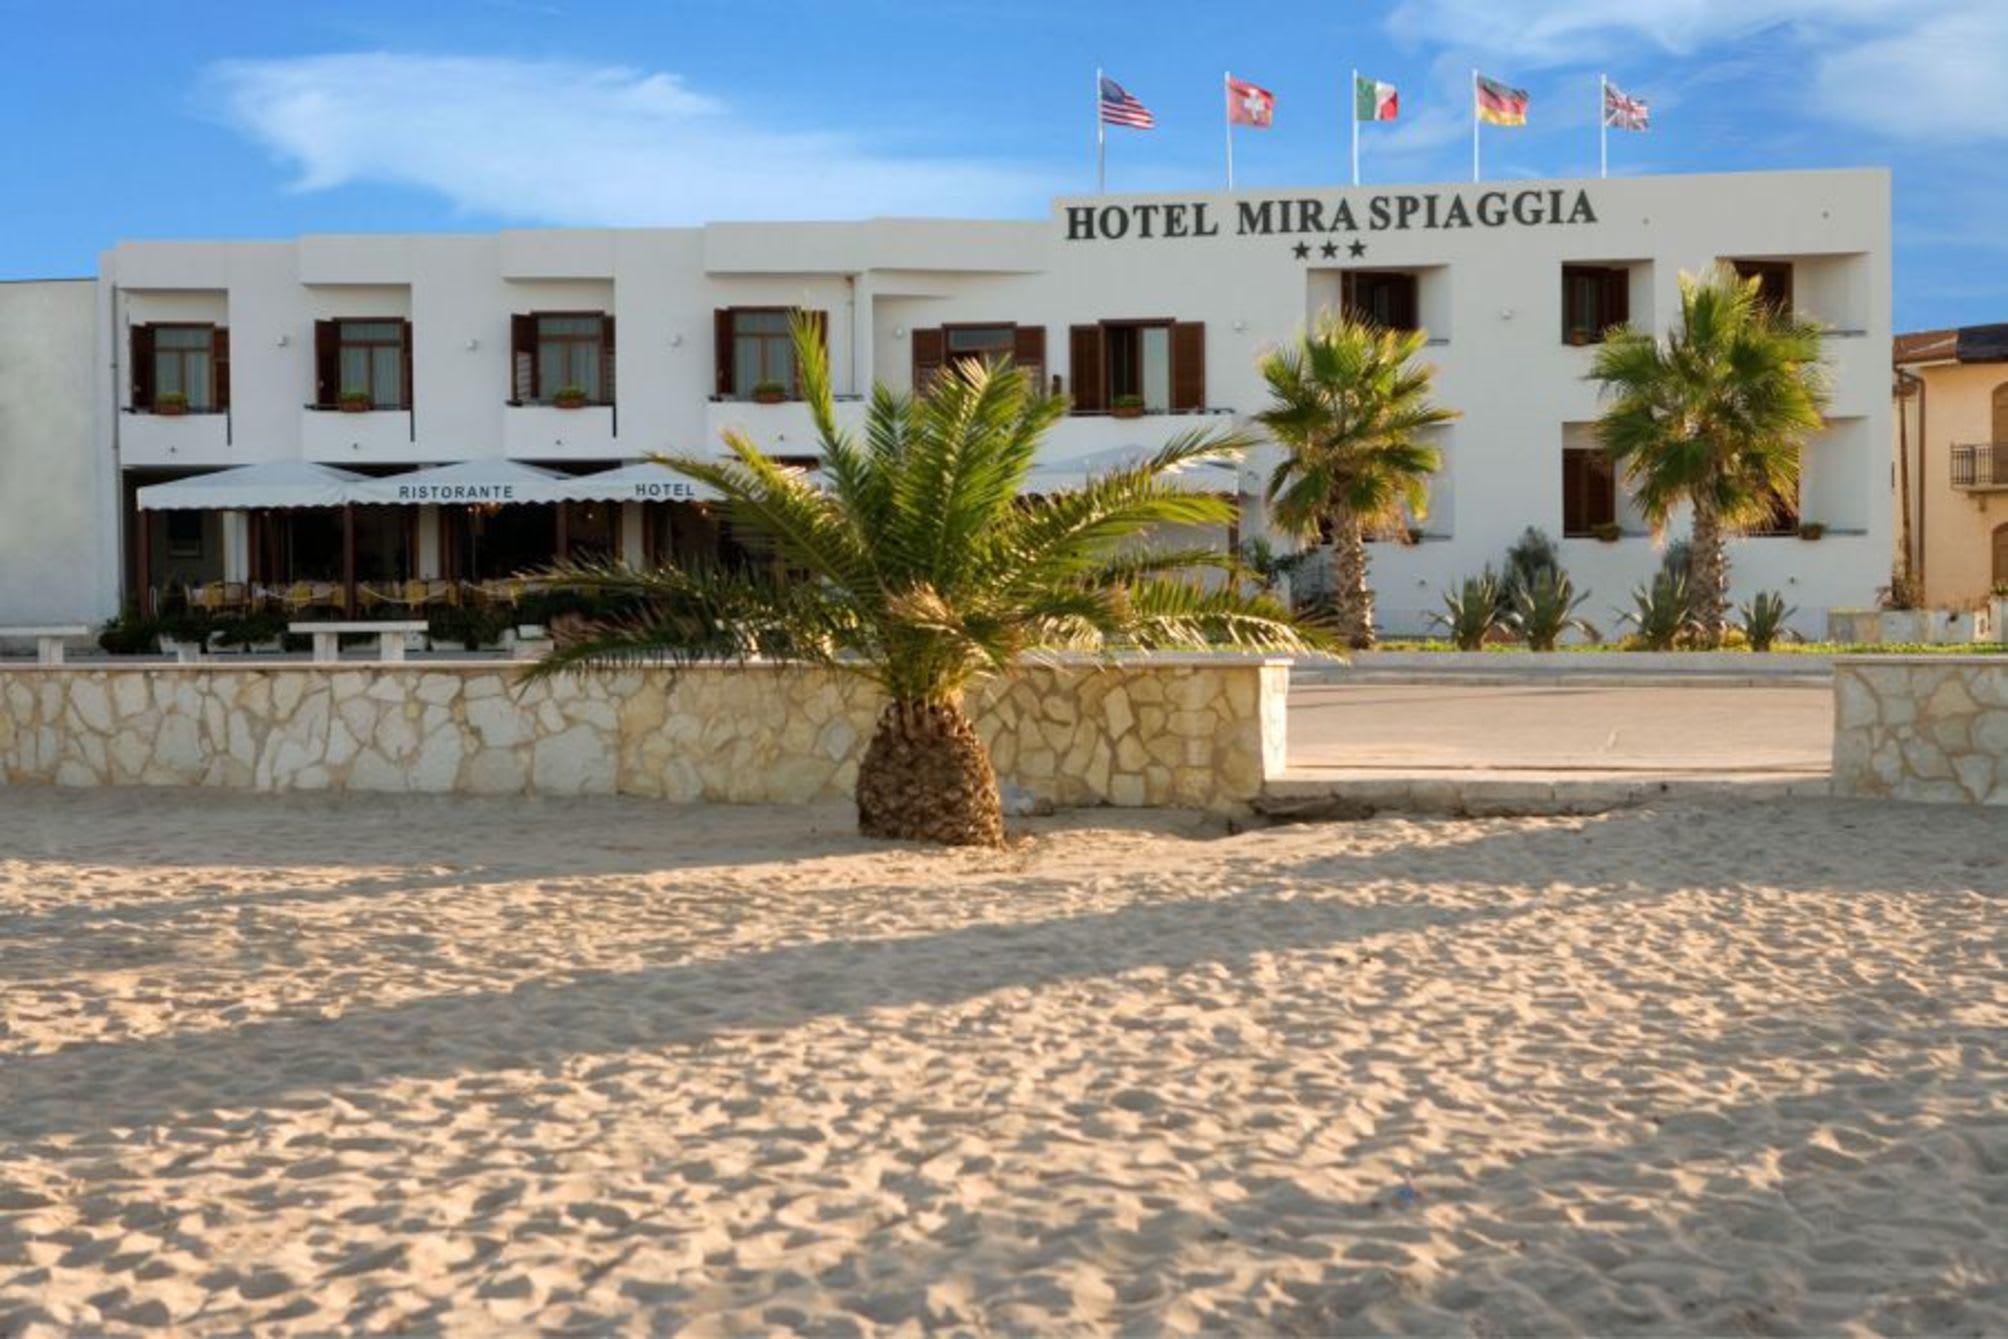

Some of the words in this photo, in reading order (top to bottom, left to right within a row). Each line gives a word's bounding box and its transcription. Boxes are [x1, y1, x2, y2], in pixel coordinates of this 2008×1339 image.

[1065, 203, 1218, 241] HOTEL
[1236, 198, 1360, 236] MIRA
[1368, 189, 1599, 232] SPIAGGIA
[399, 486, 513, 499] RISTORANTE
[635, 483, 695, 496] HOTEL
